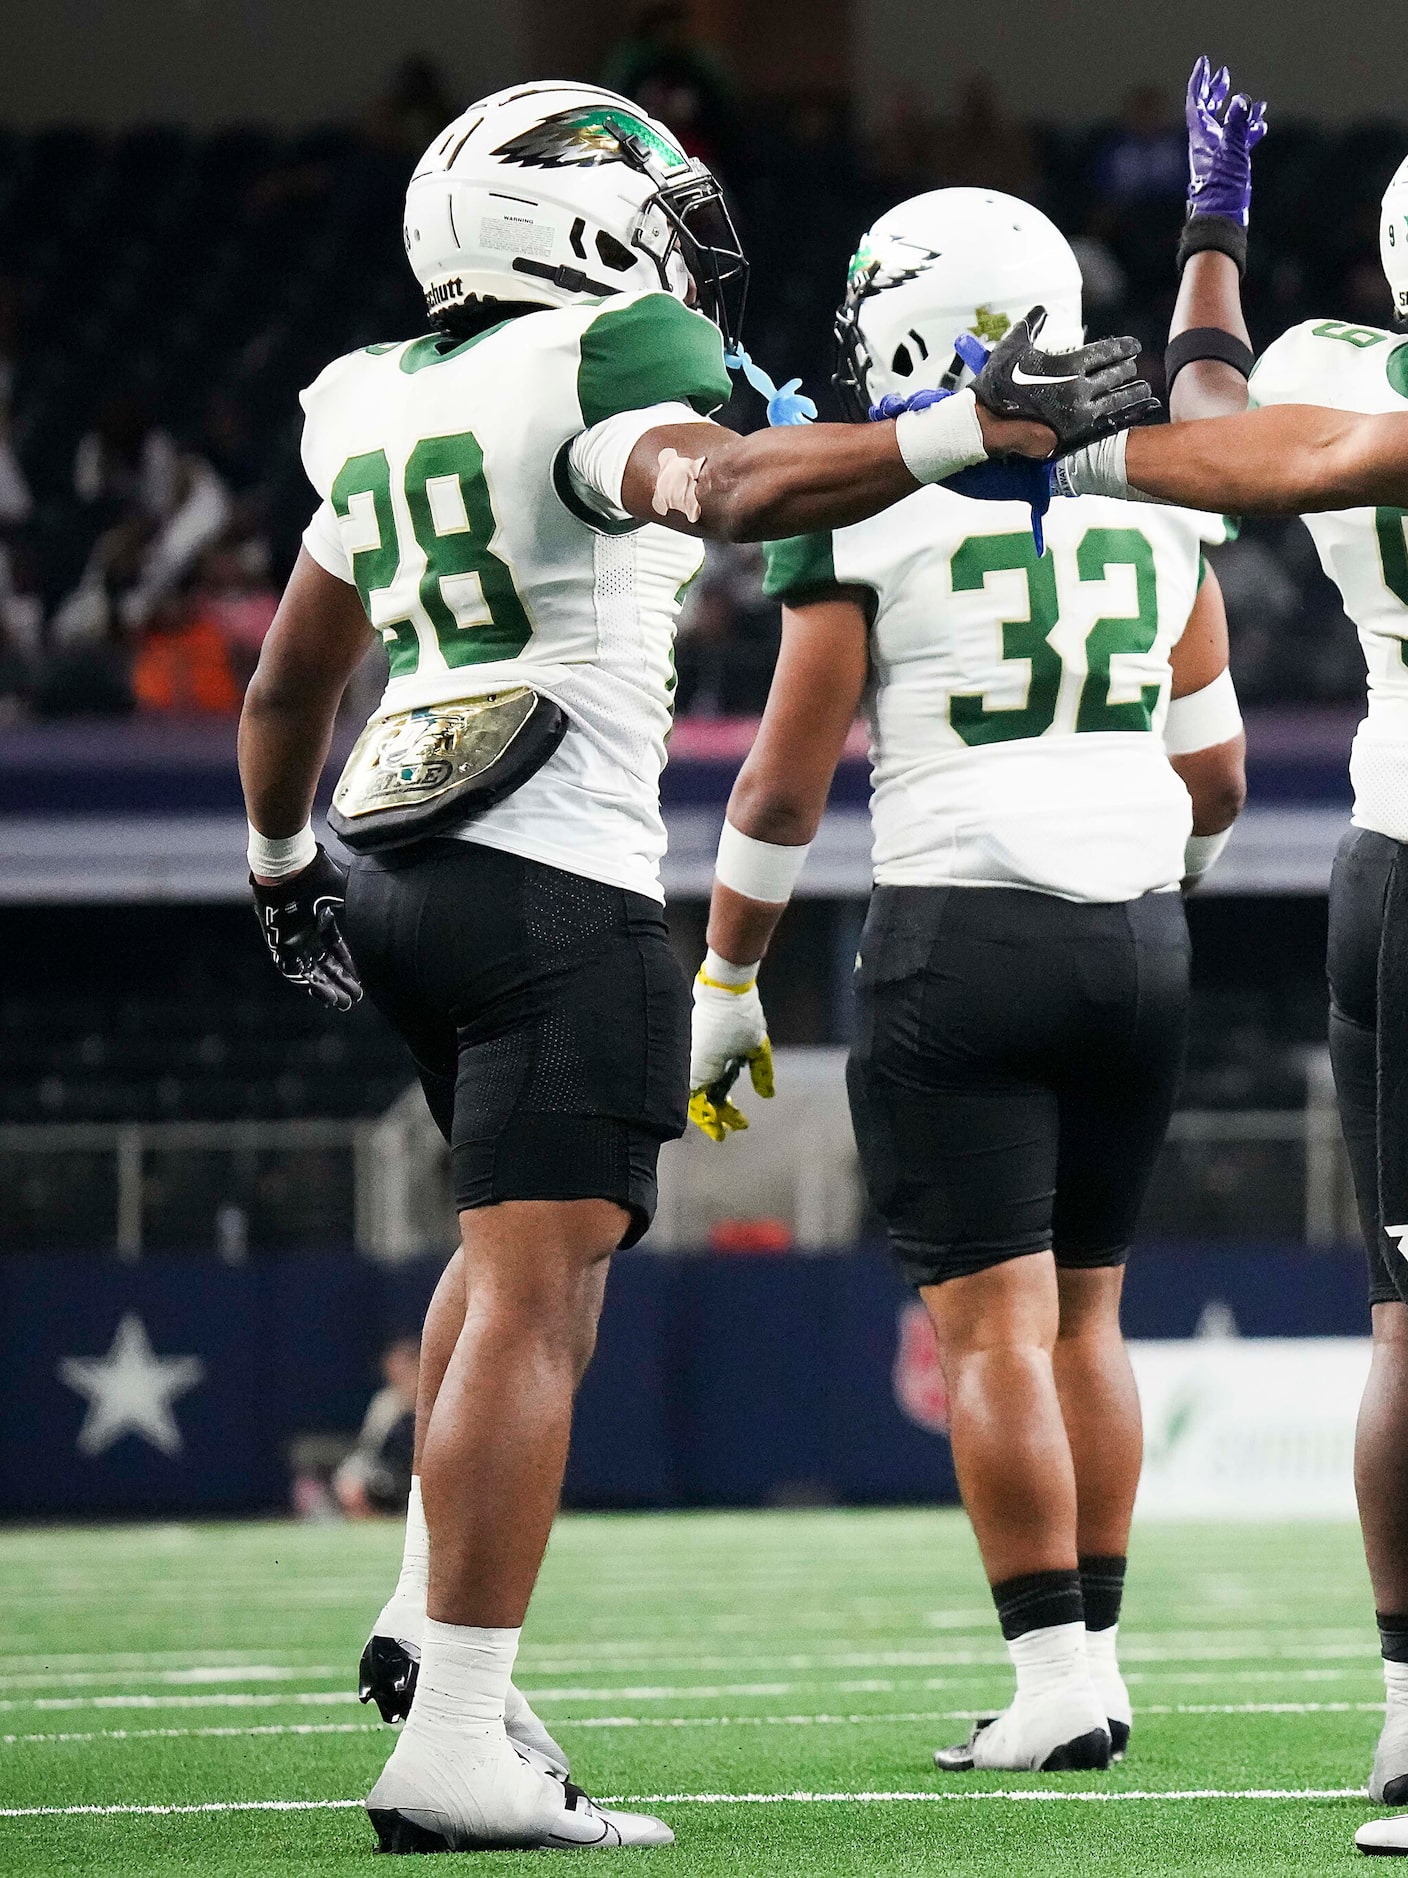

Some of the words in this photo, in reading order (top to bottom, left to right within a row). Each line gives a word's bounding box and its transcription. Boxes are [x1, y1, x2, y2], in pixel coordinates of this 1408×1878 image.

[504, 215, 534, 225] WARNING
[1388, 224, 1396, 248] 9
[330, 429, 535, 680] 28
[948, 527, 1162, 747] 32
